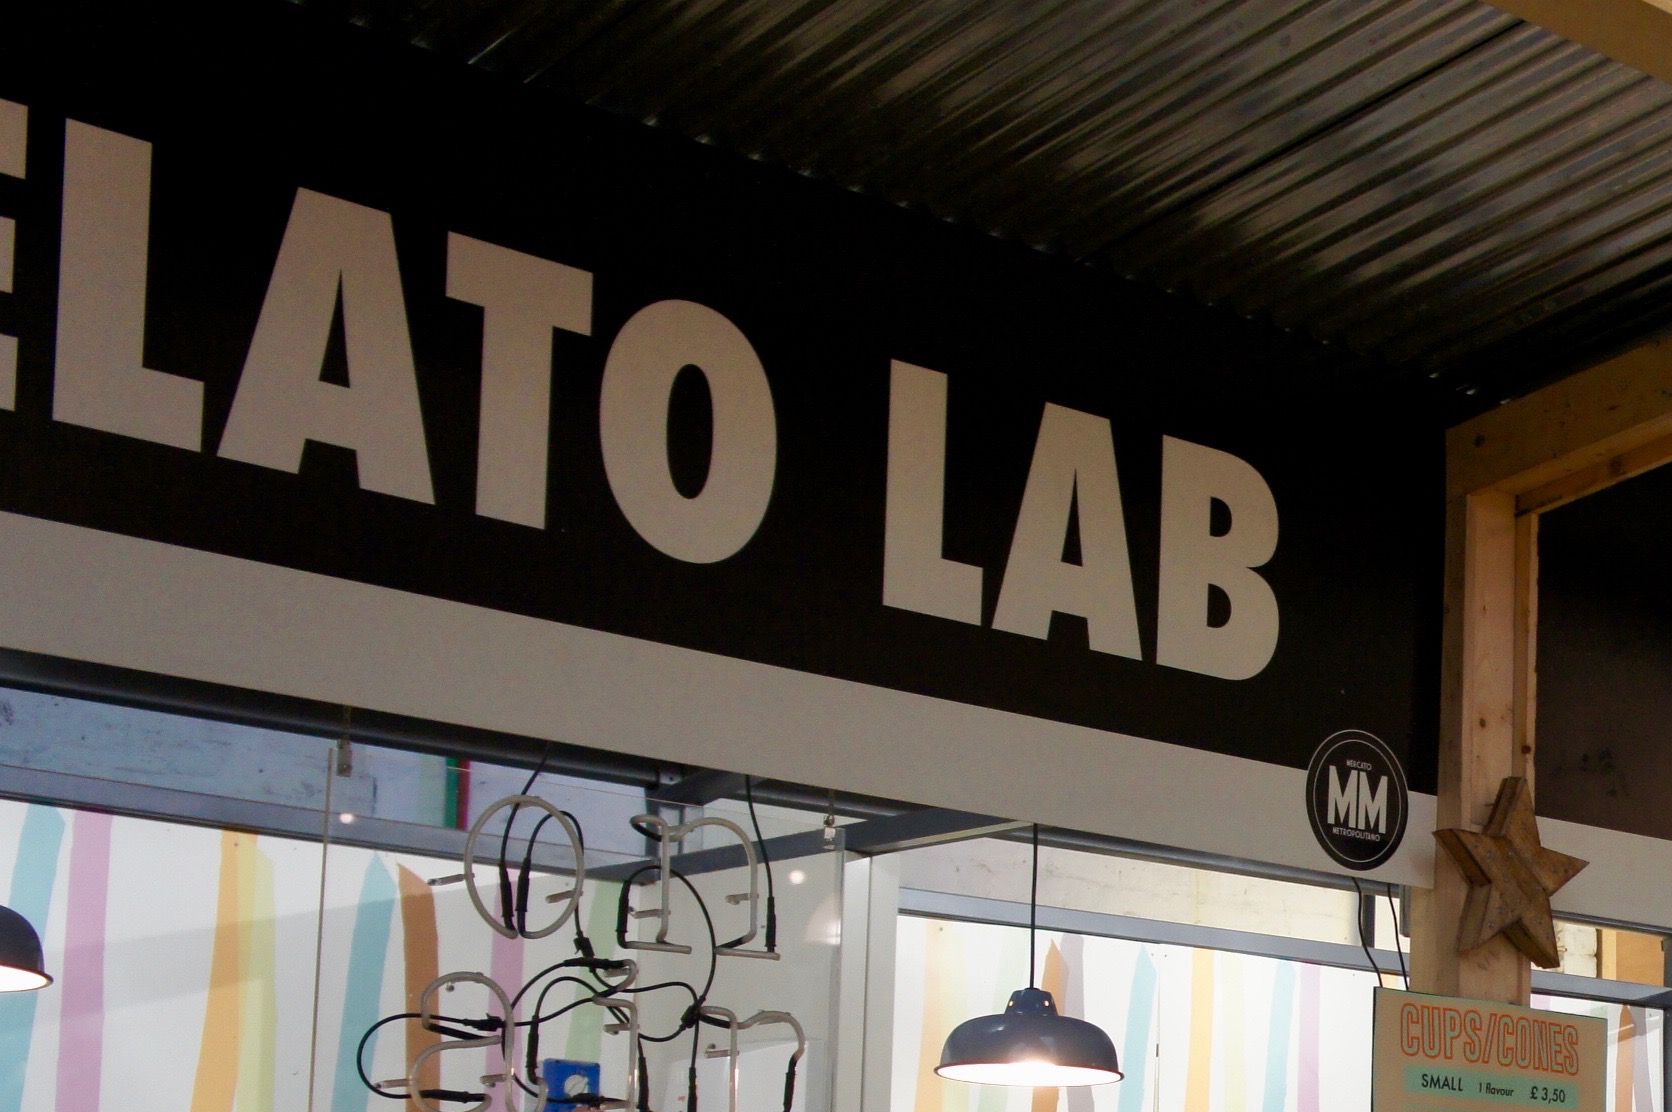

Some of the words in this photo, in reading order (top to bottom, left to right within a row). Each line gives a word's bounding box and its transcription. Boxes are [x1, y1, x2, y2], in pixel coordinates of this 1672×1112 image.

[0, 99, 777, 564] LATO
[882, 358, 1279, 681] LAB
[1346, 759, 1372, 771] MERCATO
[1328, 765, 1388, 834] MM
[1332, 827, 1380, 841] METROPOLITANO
[1400, 1002, 1580, 1076] CUPS/CONES
[1421, 1073, 1463, 1092] SMALL
[1485, 1083, 1514, 1097] flavour
